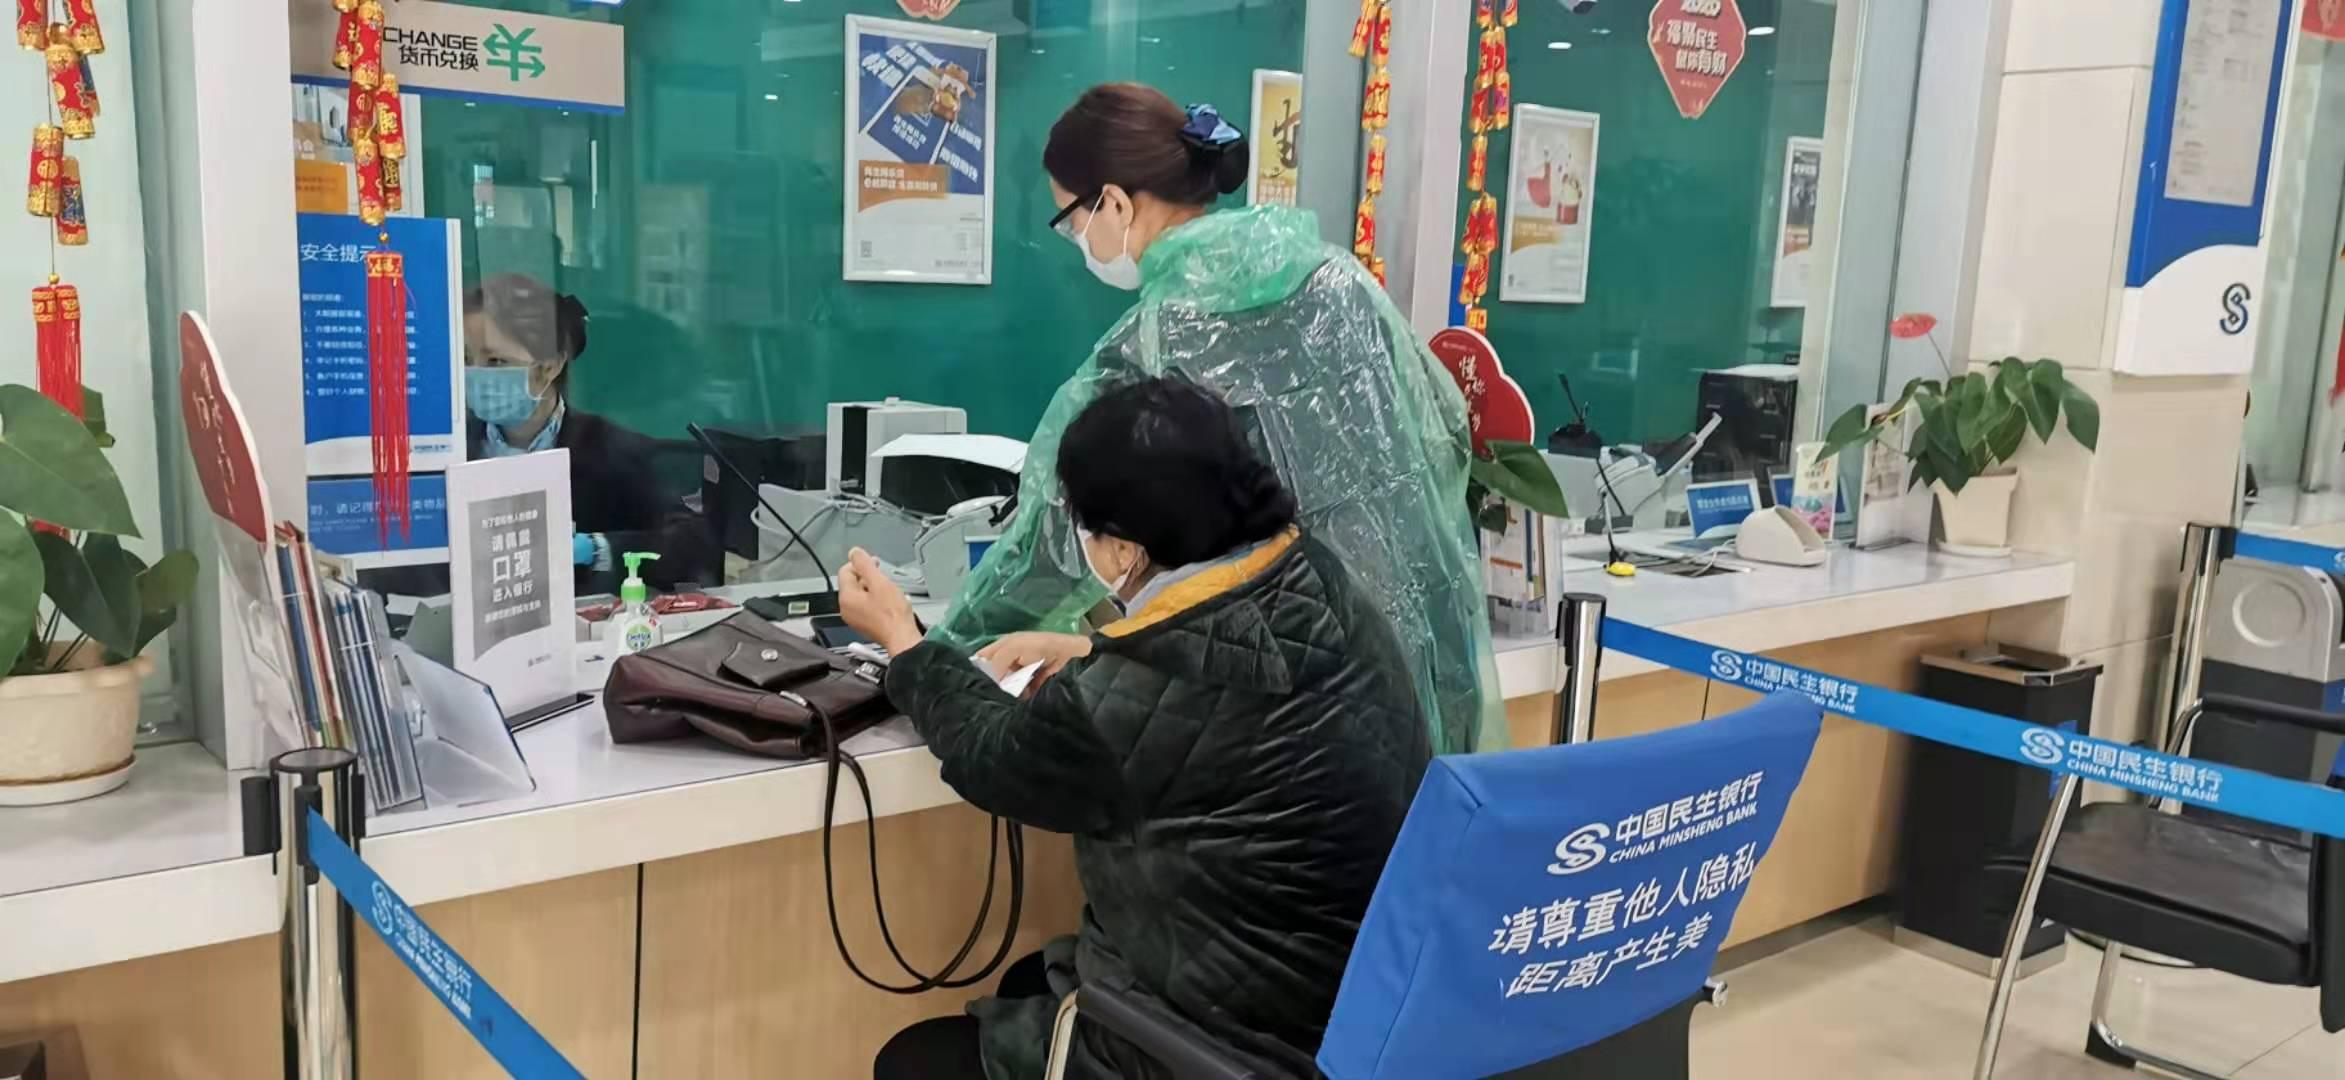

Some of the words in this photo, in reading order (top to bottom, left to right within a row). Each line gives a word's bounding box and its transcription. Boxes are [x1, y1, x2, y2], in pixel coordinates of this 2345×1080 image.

[382, 26, 478, 51] CHANGE
[399, 46, 479, 71] 货币兑换
[493, 549, 532, 584] 口罩
[493, 579, 534, 602] 进入银行
[1745, 658, 1858, 704] 中国民生银行
[1827, 698, 1857, 715] BANK
[2067, 758, 2107, 777] CHINA
[2110, 768, 2178, 795] MINSHENG
[2182, 785, 2219, 803] BANK
[2069, 739, 2223, 791] 中国民生银行
[1616, 771, 1764, 846] 中国民生银行
[1609, 841, 1656, 864] CHINA
[1659, 813, 1724, 850] MINSHENG
[1726, 801, 1758, 827] BANK
[1488, 842, 1757, 955] 请尊重他人隐私
[1505, 911, 1713, 998] 距离产生美
